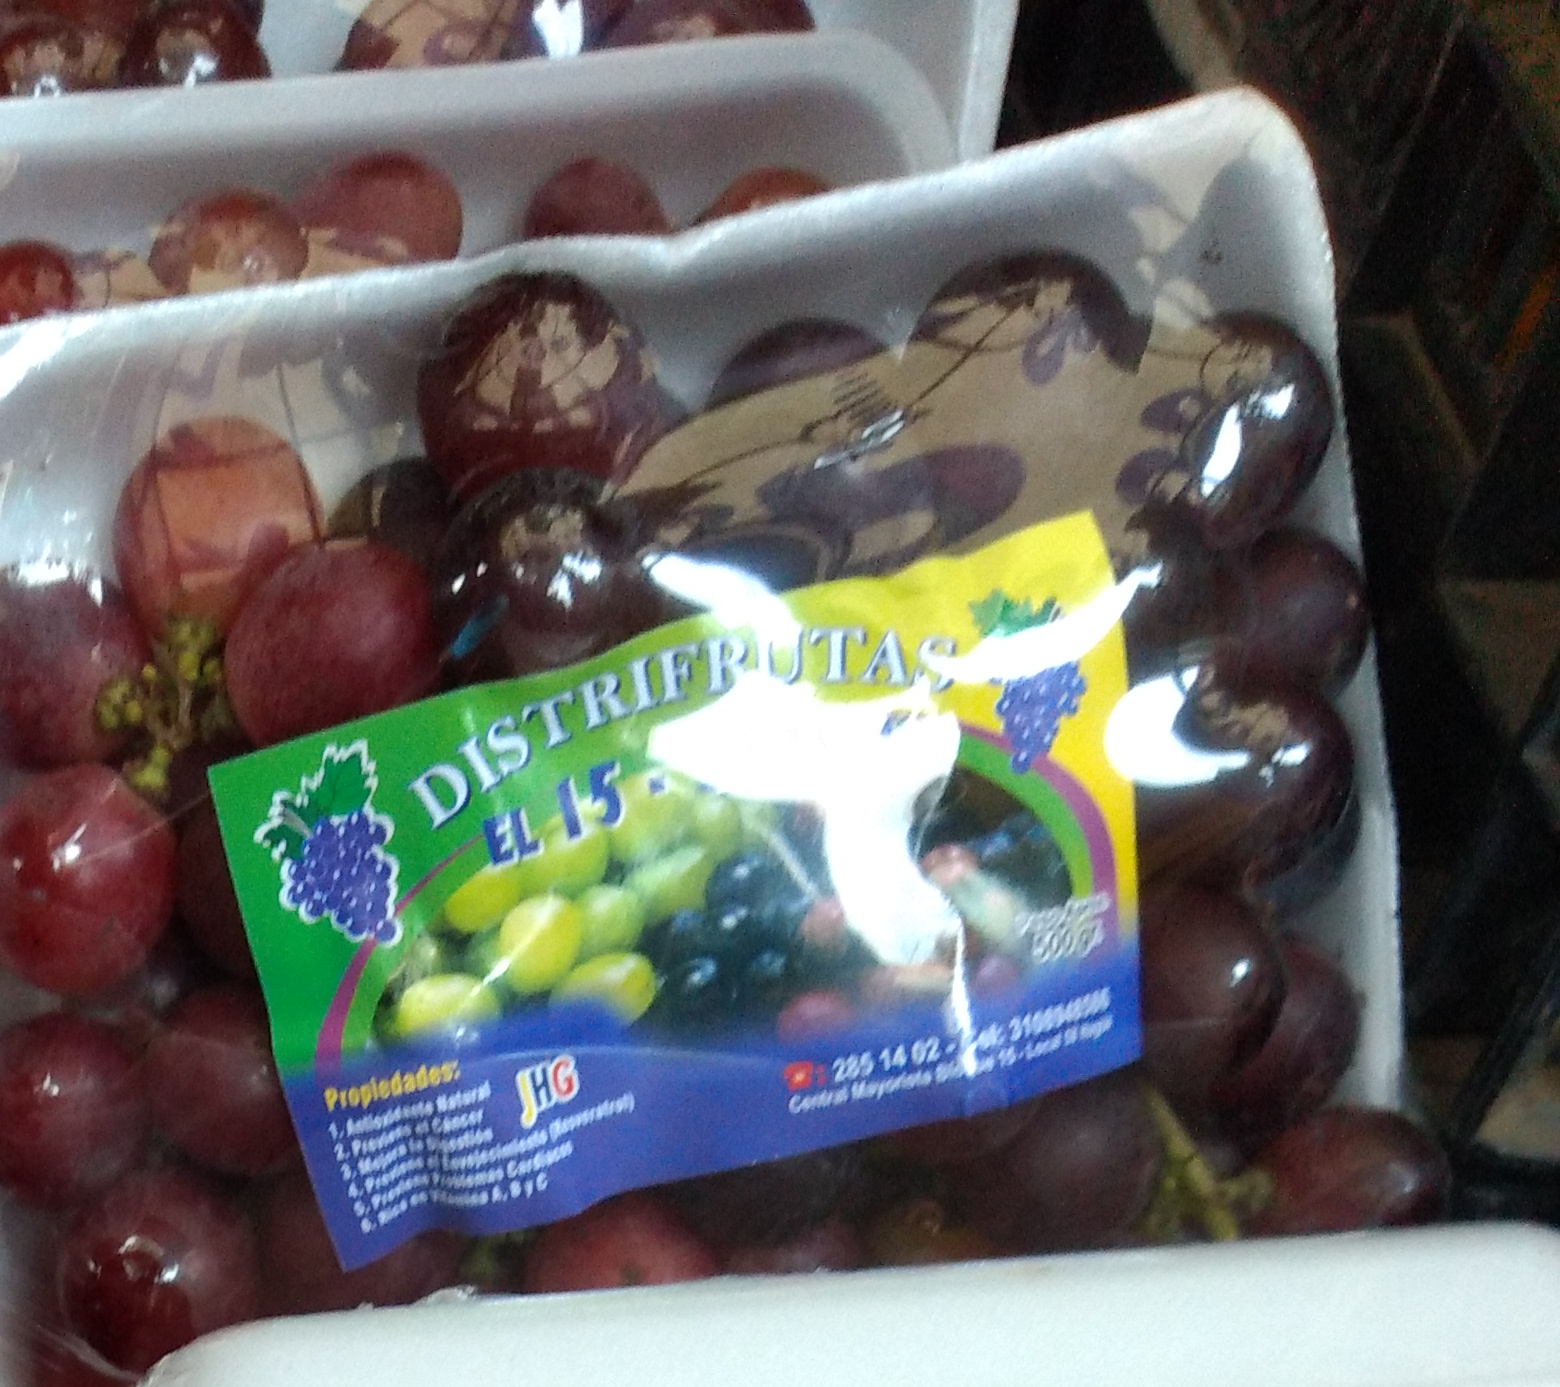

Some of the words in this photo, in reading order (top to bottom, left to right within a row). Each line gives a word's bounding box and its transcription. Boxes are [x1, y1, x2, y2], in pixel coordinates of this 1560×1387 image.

[481, 806, 544, 867] EL
[555, 761, 625, 842] 15
[879, 1043, 908, 1072] 14
[911, 1036, 941, 1066] 02
[323, 1060, 461, 1112] Propiedades:
[514, 1054, 581, 1129] JHG
